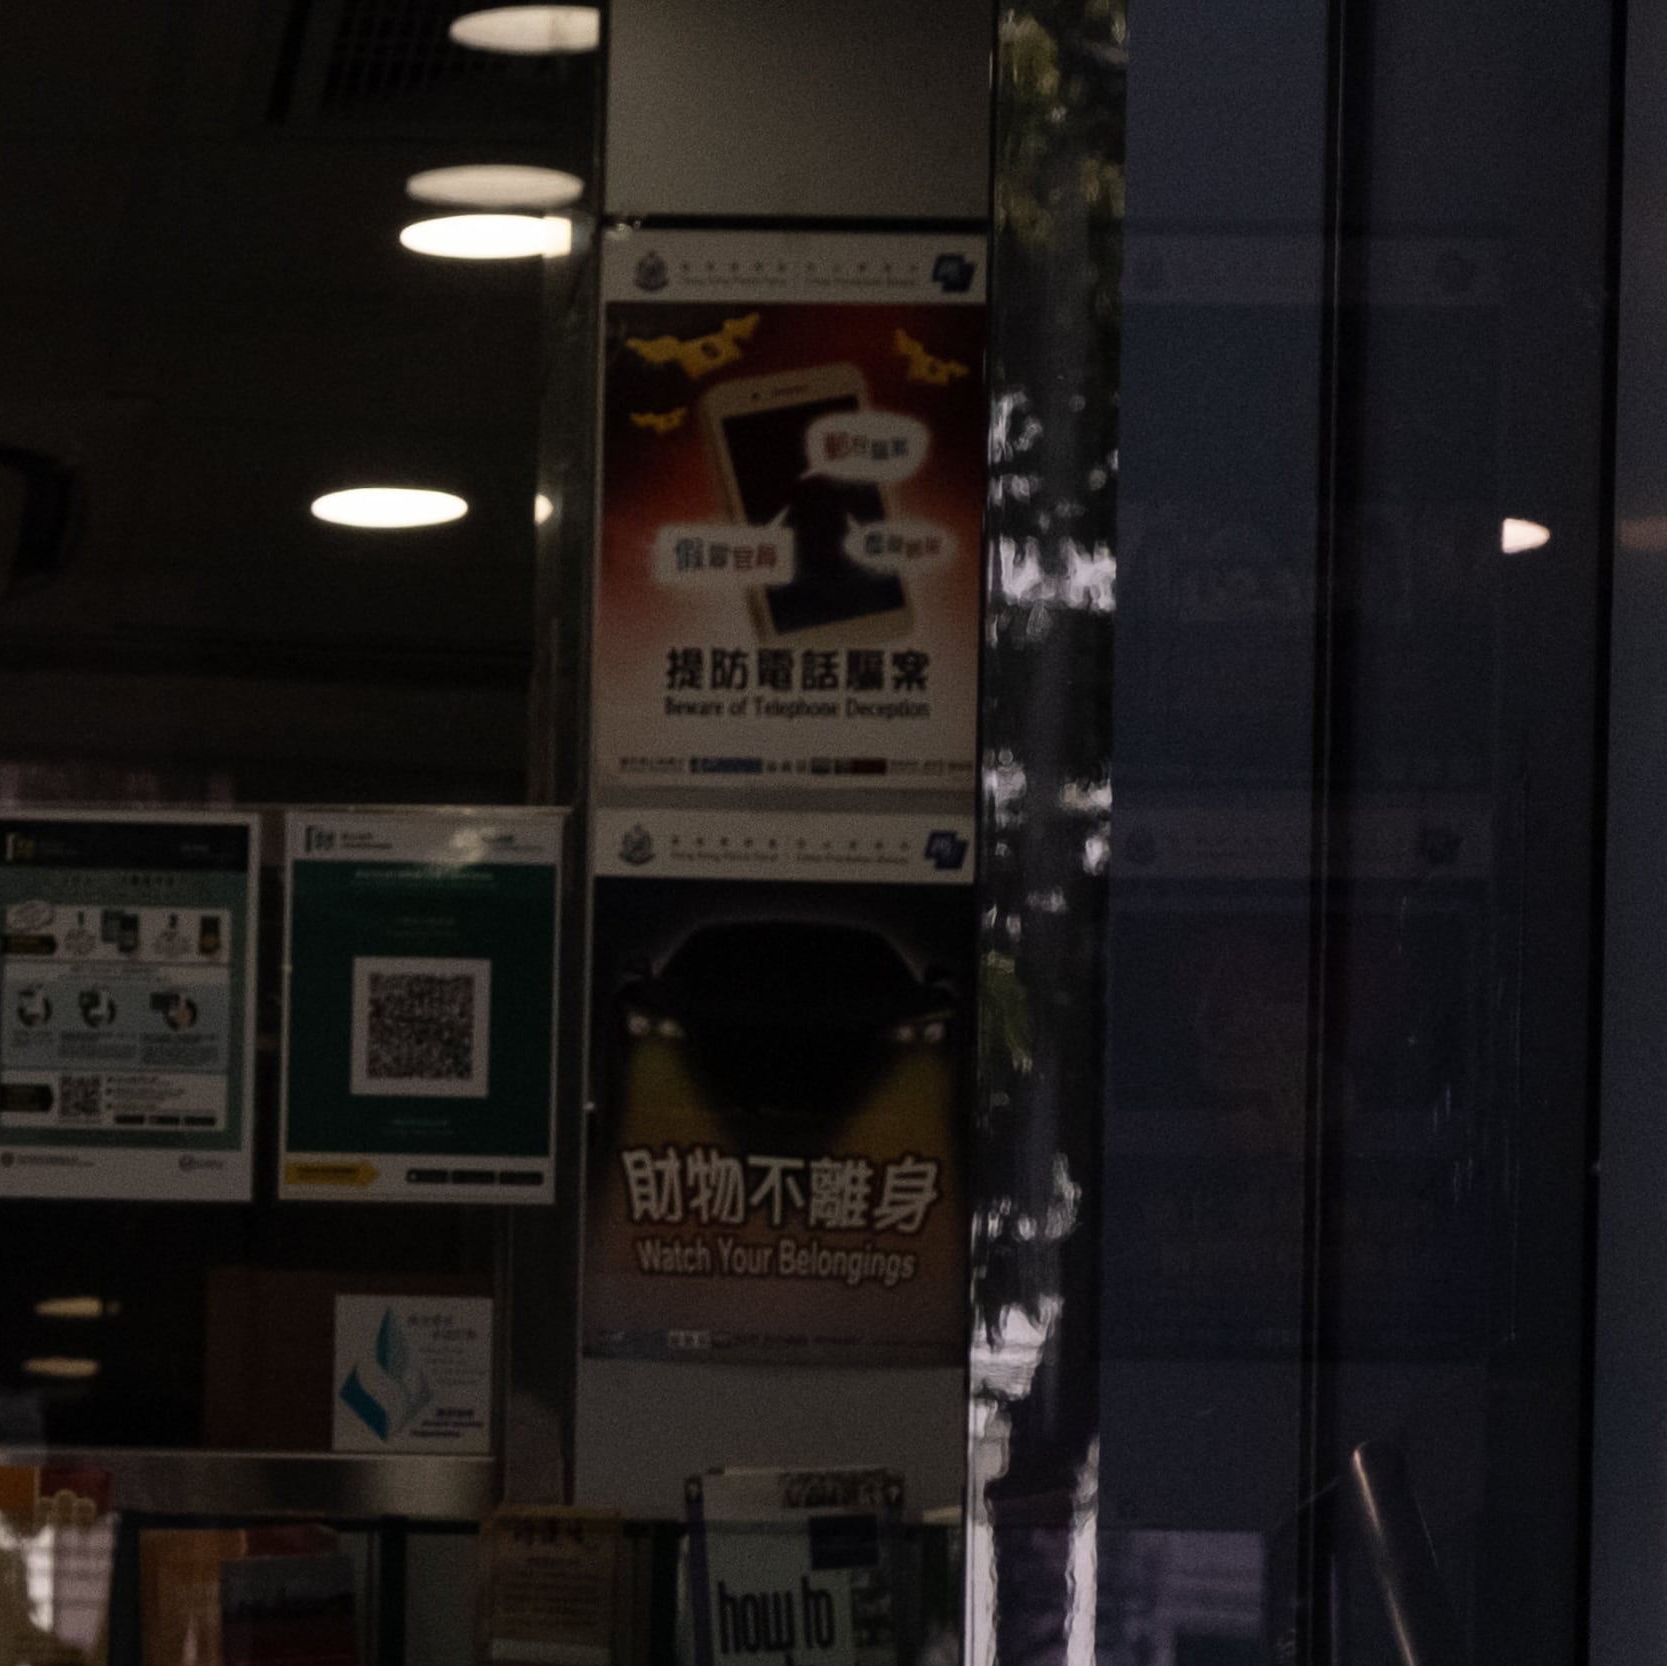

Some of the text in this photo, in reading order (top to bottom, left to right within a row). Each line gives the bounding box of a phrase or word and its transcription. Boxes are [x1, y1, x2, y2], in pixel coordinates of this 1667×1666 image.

[667, 648, 930, 692] 提防電話騙案
[665, 697, 931, 719] Beware of Telephone Deception
[620, 1145, 941, 1235] 財物不離身
[635, 1237, 917, 1287] Watch Your Belongings
[718, 1575, 836, 1655] how to
